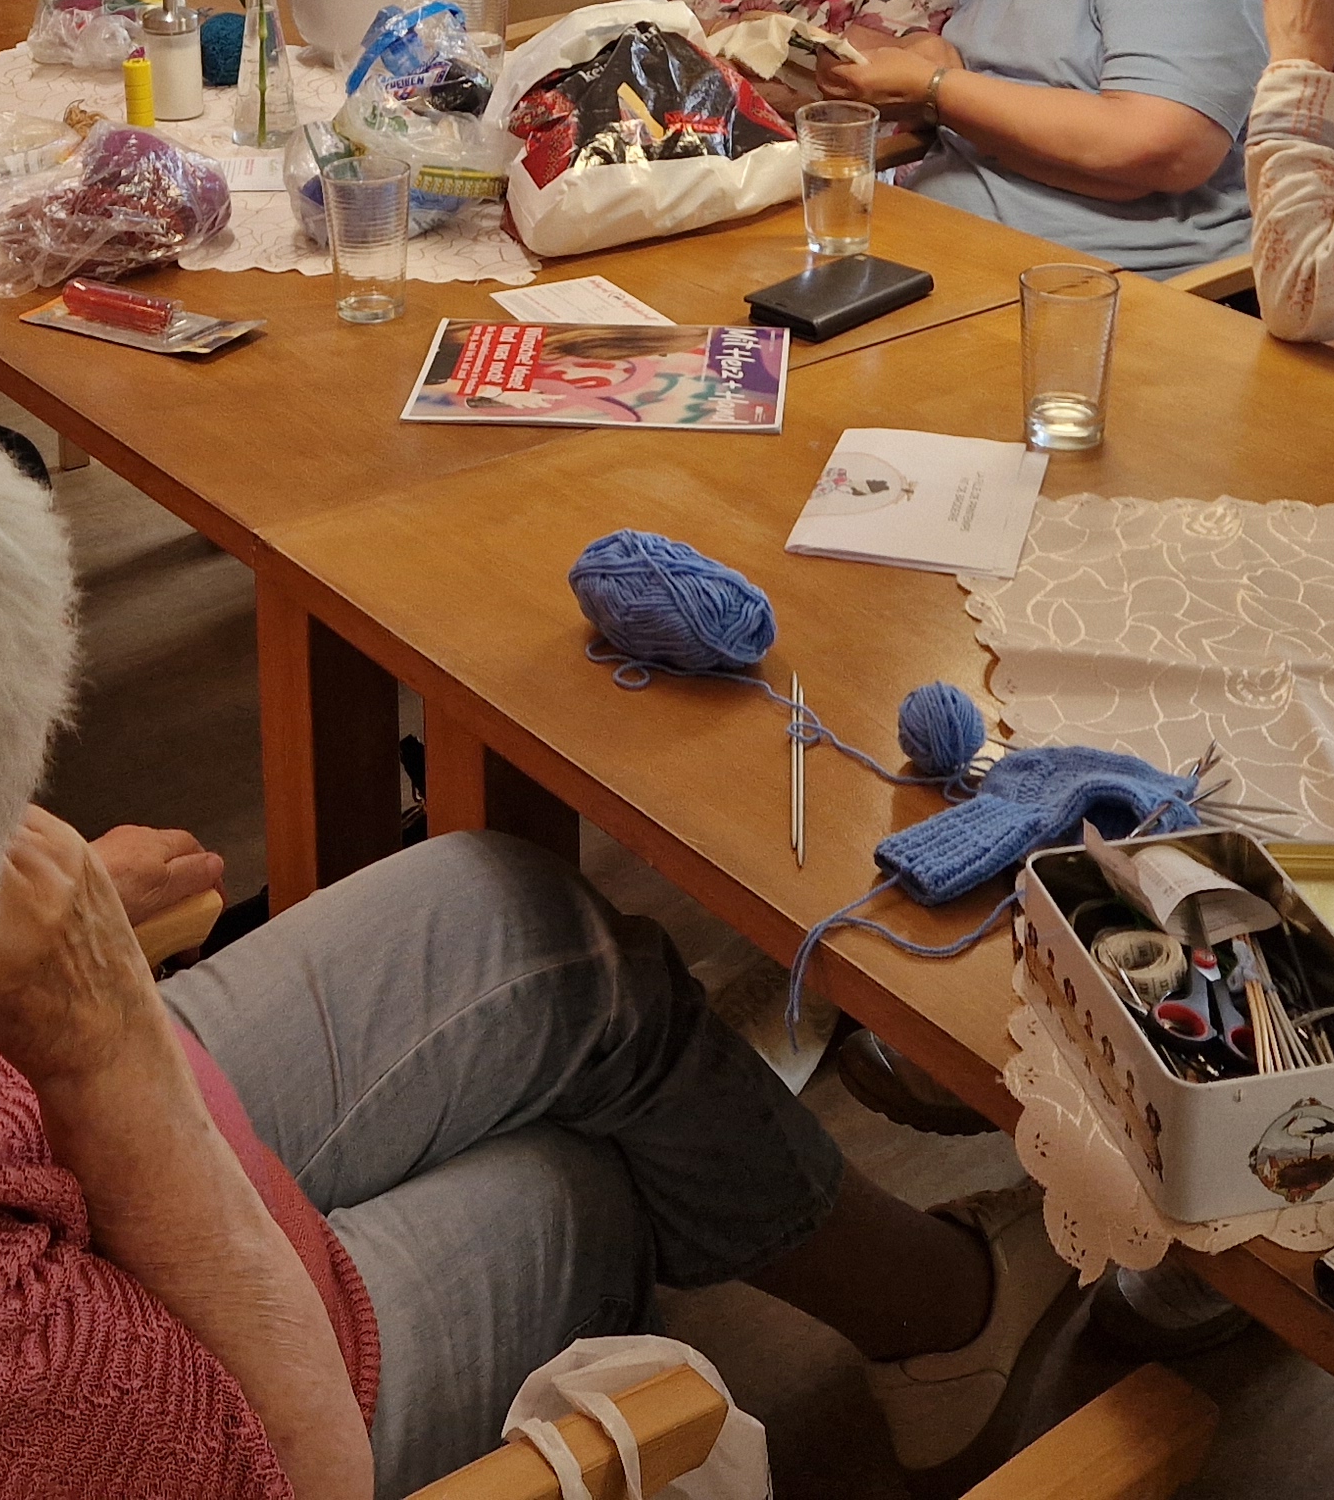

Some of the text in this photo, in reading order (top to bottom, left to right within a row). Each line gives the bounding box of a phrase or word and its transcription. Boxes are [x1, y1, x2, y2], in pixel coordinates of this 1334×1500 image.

[515, 327, 543, 365] Wünsche?
[708, 327, 762, 424] Mit Herz + Hand
